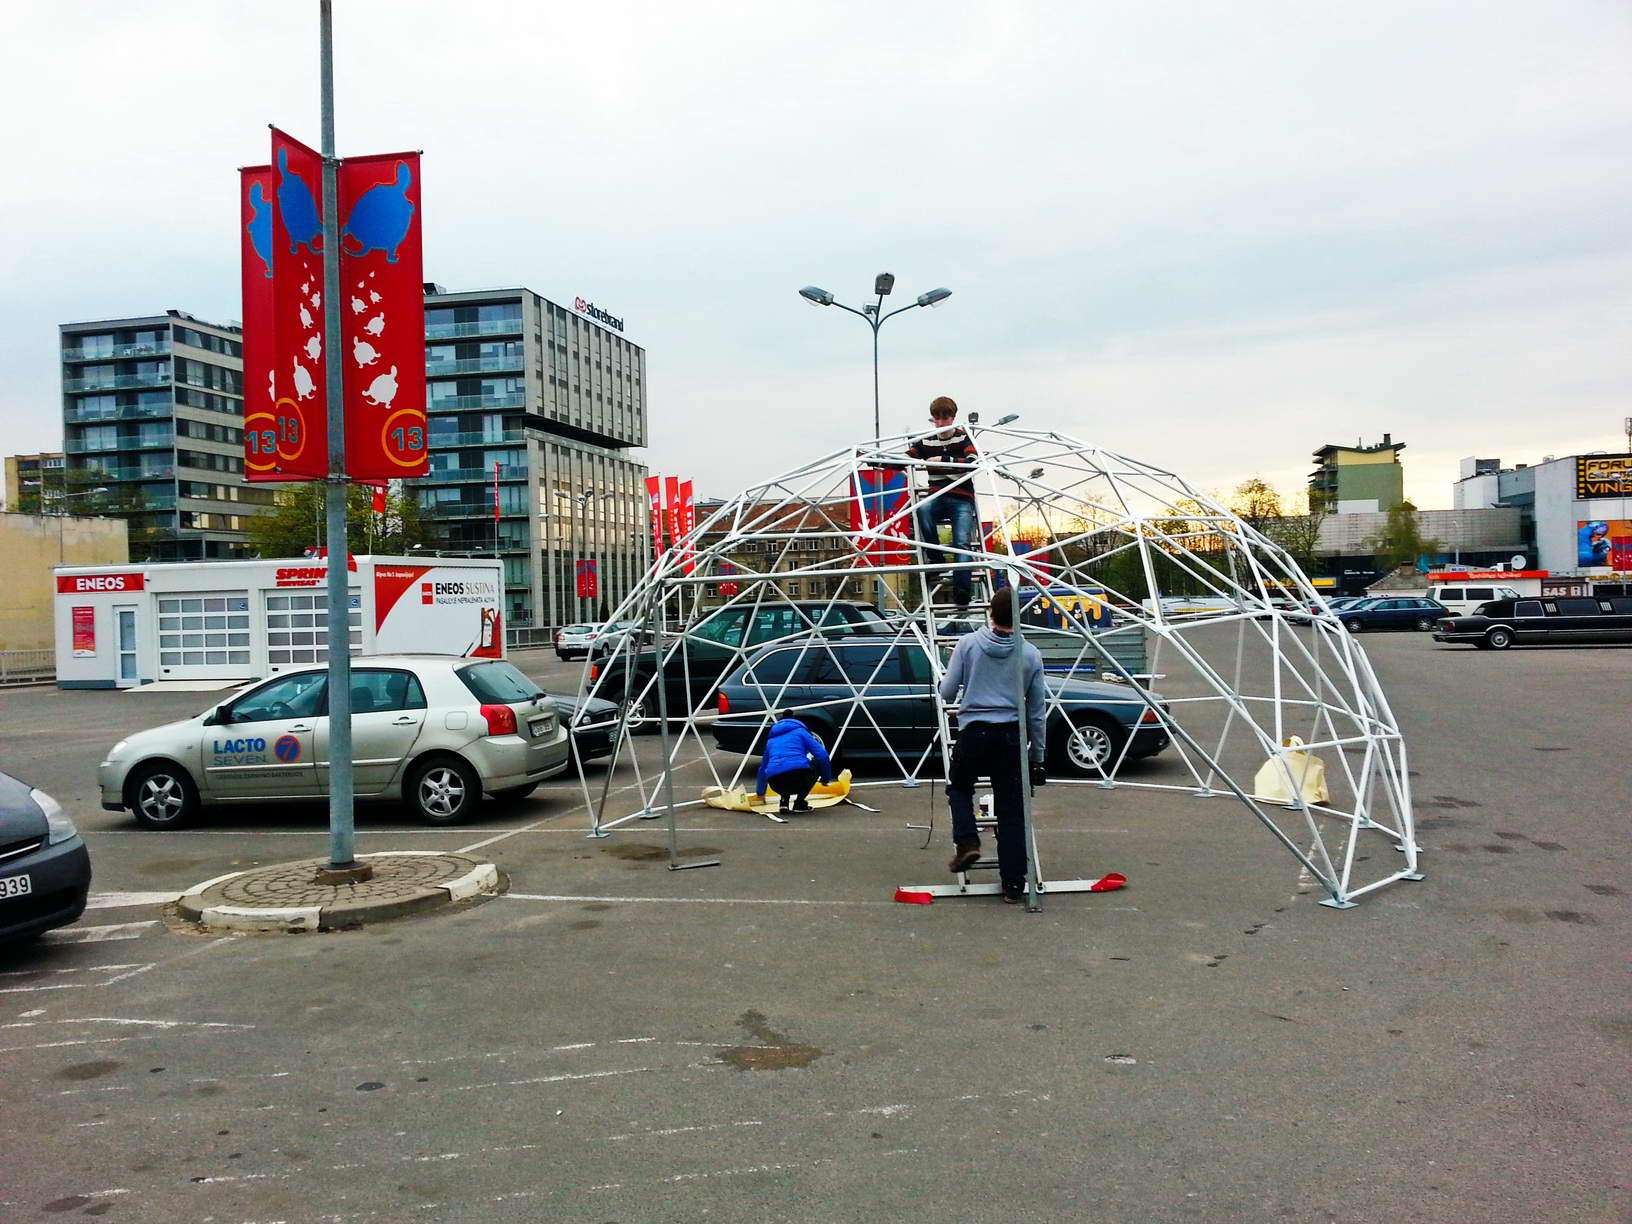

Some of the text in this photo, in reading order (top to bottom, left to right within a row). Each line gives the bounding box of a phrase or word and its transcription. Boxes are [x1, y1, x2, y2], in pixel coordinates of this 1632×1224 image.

[586, 302, 624, 332] storebrand
[277, 416, 299, 443] 13
[391, 427, 423, 450] 13
[246, 430, 276, 453] 13
[275, 567, 328, 580] SPRIN
[76, 576, 125, 591] ENEOS
[435, 582, 465, 595] ENEOS
[1542, 587, 1567, 597] SAS
[213, 737, 267, 755] LACTO
[213, 754, 267, 766] SEVEN
[0, 876, 29, 898] 939
